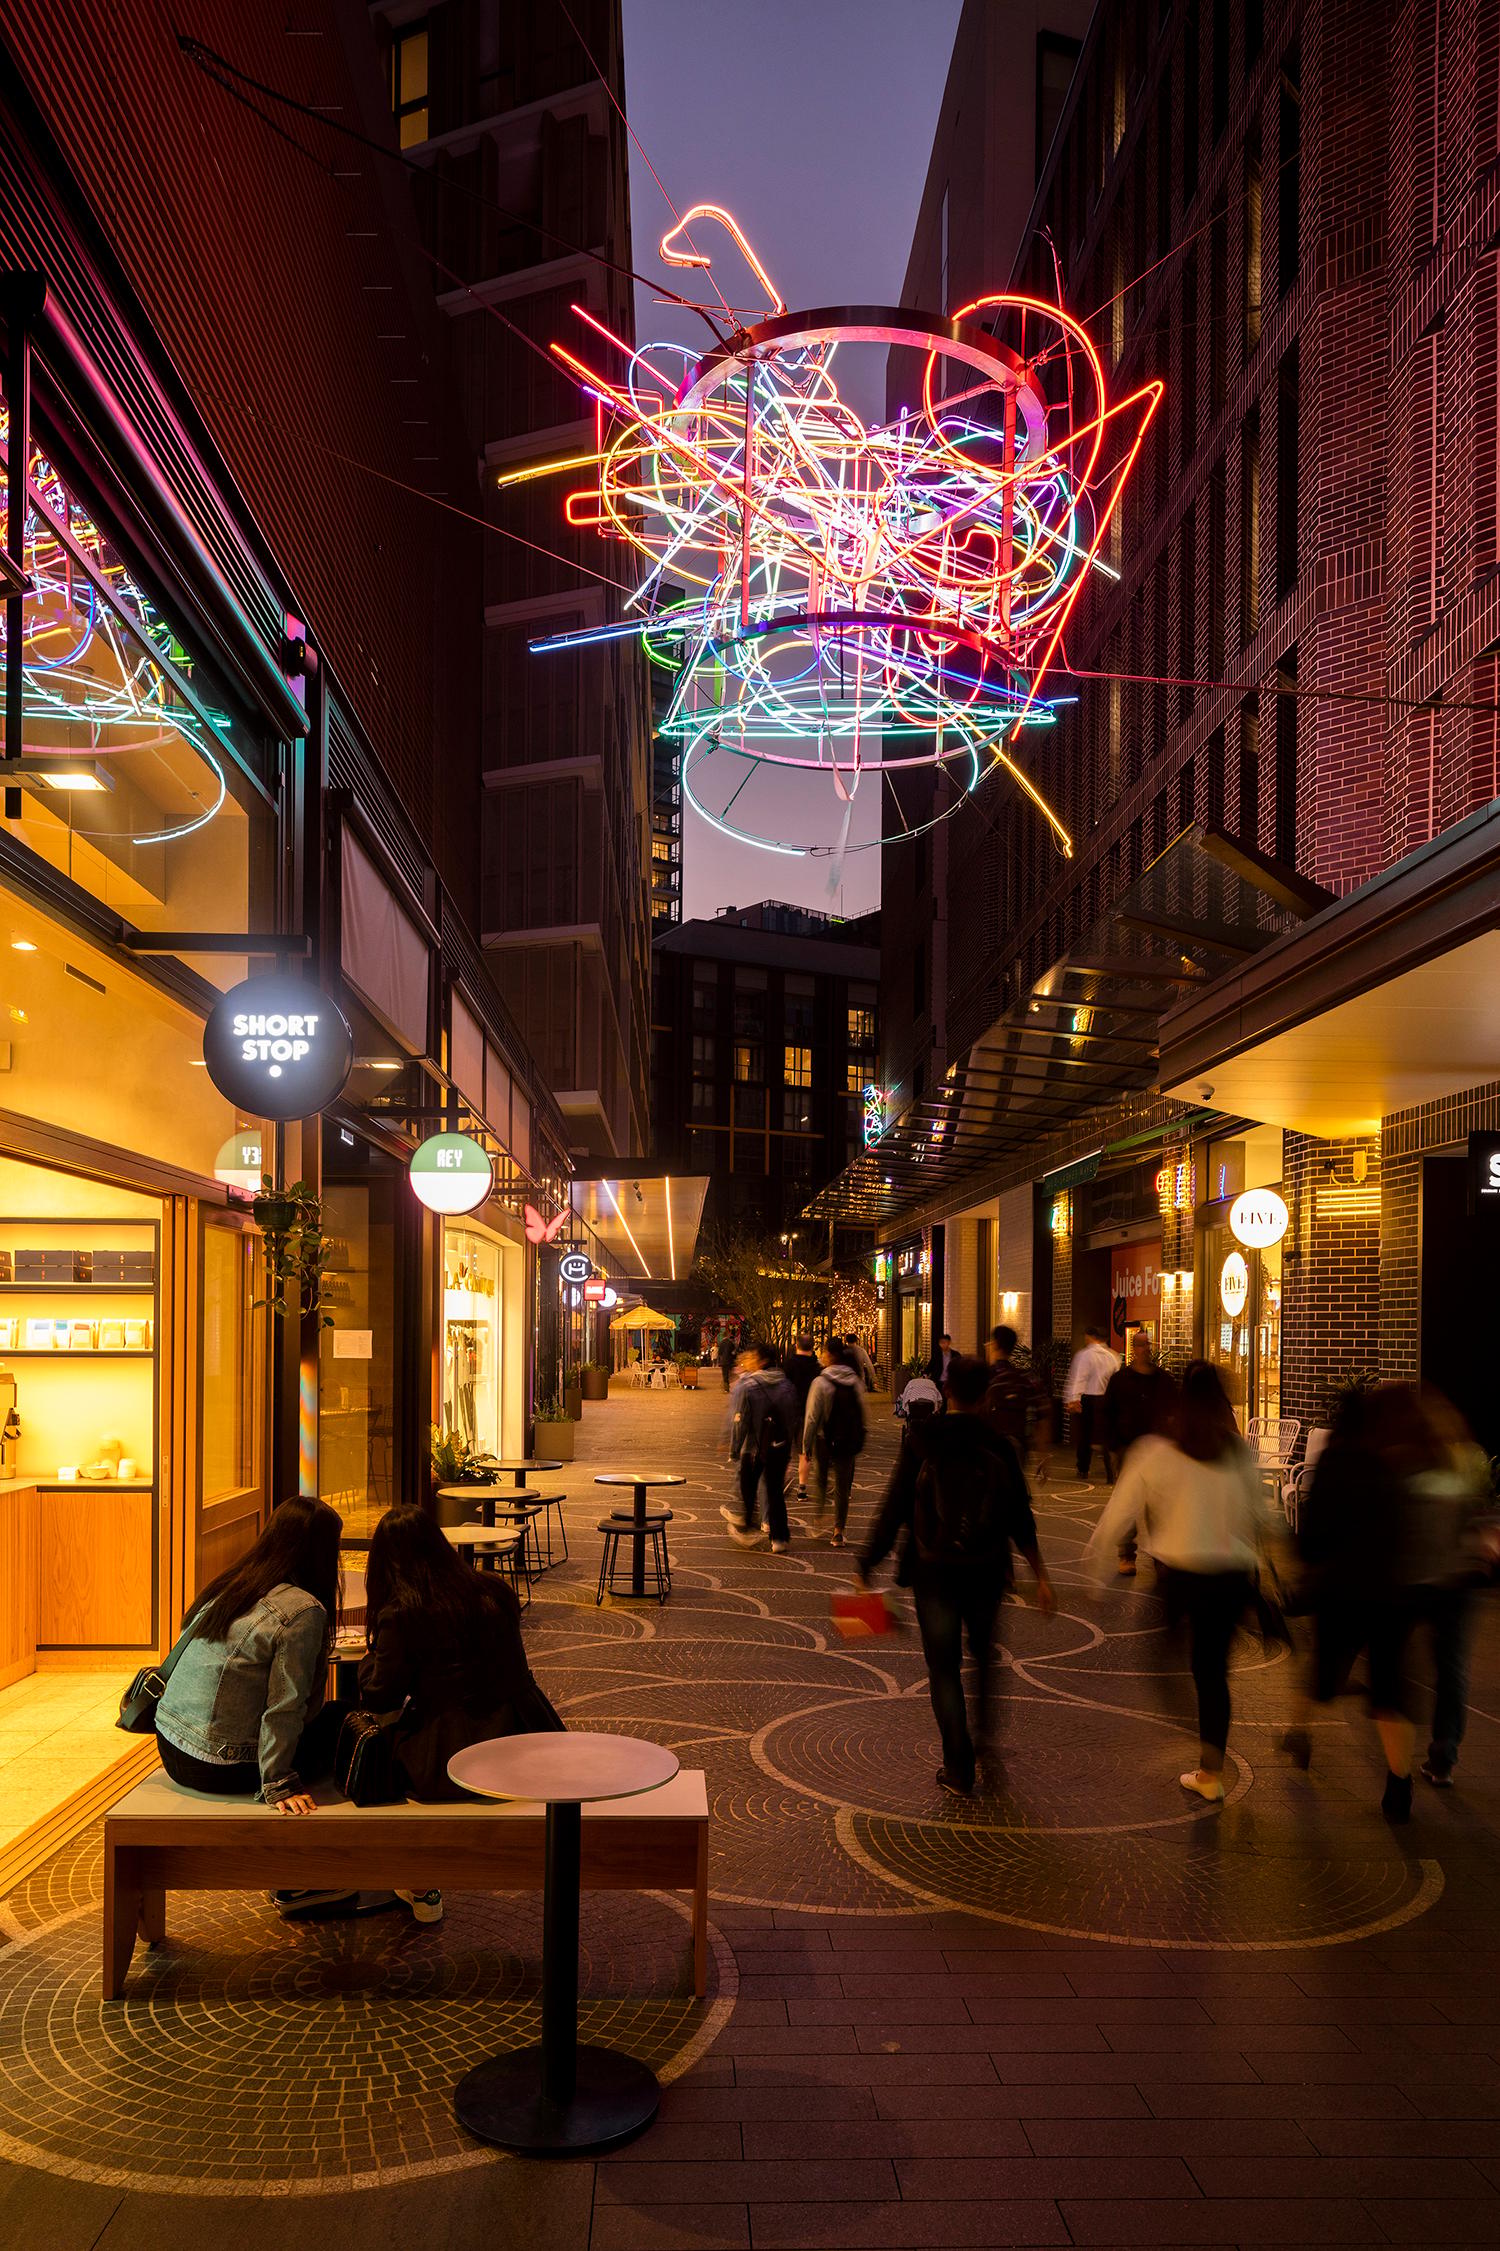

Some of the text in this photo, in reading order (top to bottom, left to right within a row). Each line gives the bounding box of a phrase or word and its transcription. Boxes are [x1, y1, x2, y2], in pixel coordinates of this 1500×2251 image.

[233, 1014, 319, 1036] SHORT
[242, 1039, 309, 1061] STOP
[437, 1149, 463, 1168] REY
[1112, 1266, 1161, 1298] Juice Fo
